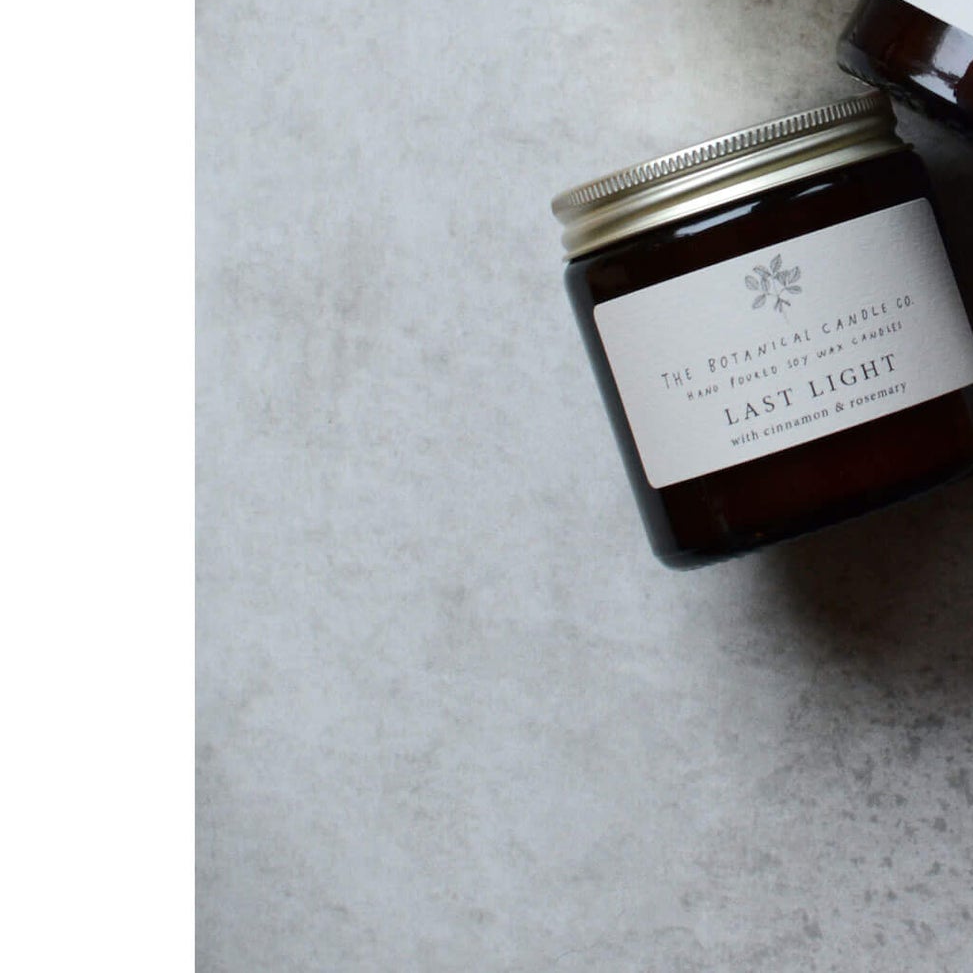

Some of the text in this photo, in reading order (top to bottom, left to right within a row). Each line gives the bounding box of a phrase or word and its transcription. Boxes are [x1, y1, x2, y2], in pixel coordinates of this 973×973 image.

[661, 295, 914, 390] THE BOTANICAL CANDLE CO.
[688, 385, 719, 400] HAND
[787, 355, 808, 369] SOY
[817, 344, 843, 358] WAX
[852, 322, 902, 344] CANDLES
[725, 354, 897, 426] LAST LIGHT
[731, 382, 907, 446] with cinnamon & rosemary
